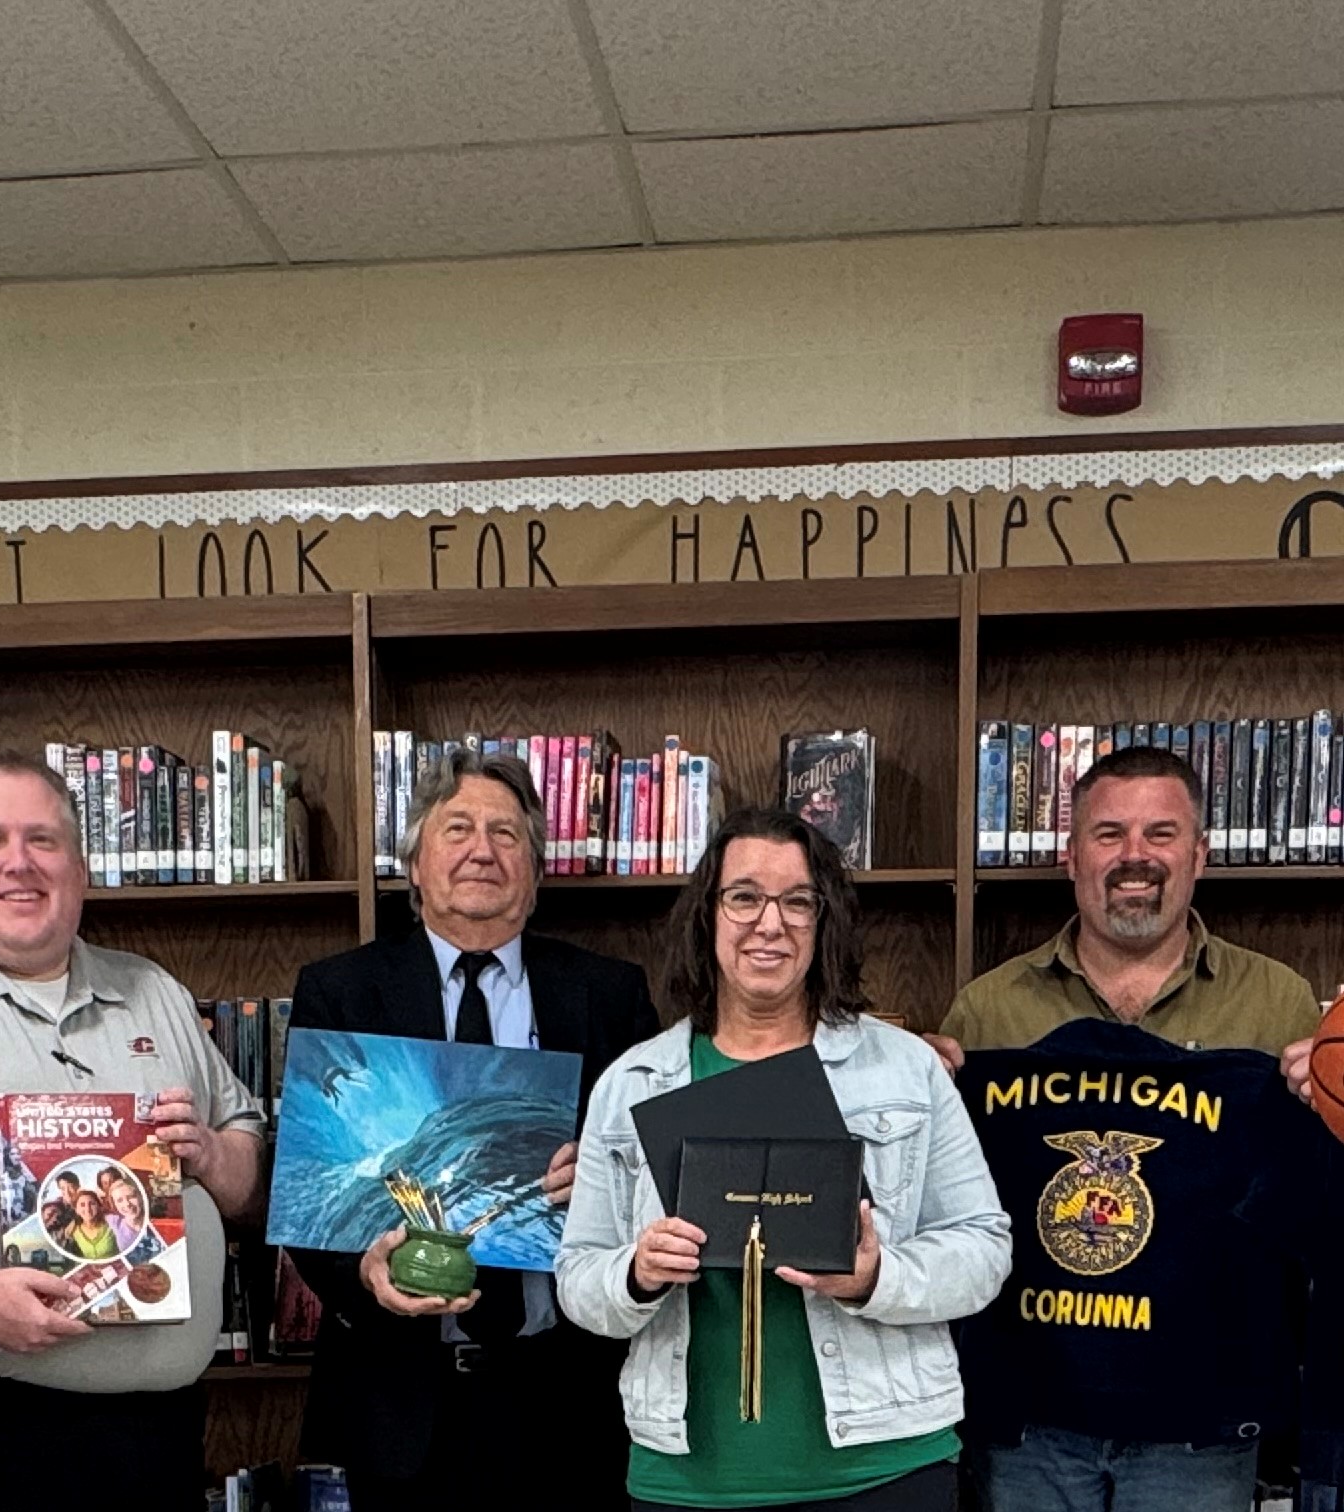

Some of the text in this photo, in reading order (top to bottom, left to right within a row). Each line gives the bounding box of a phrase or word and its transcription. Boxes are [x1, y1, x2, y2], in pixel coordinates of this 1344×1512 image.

[1084, 381, 1122, 396] FIRE
[429, 519, 557, 592] FOR
[986, 1071, 1222, 1132] MICHIGAN
[16, 1117, 125, 1138] HISTORY
[1086, 1190, 1122, 1217] FFA
[1020, 1287, 1152, 1332] CORUNNA
